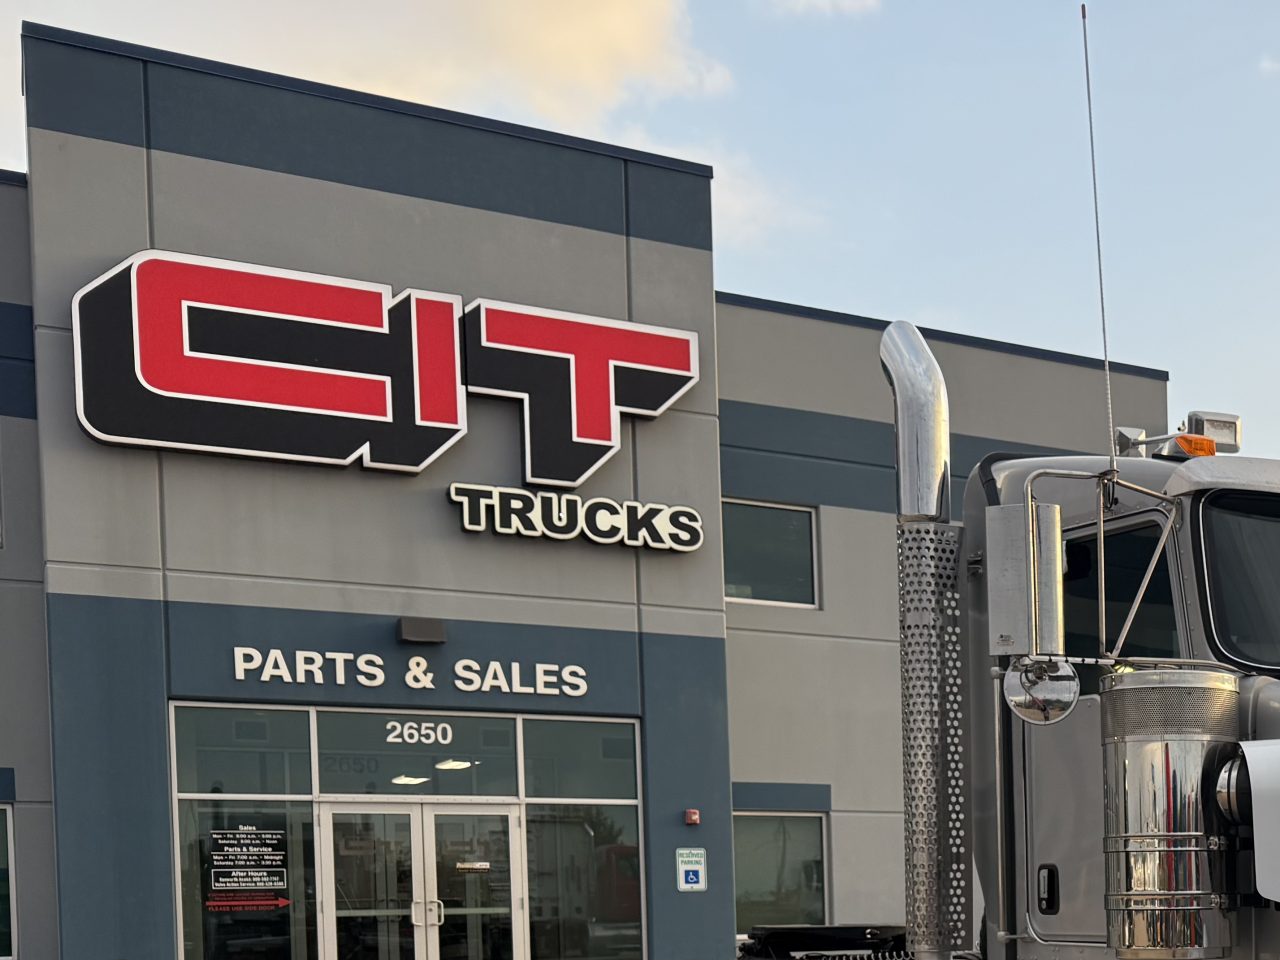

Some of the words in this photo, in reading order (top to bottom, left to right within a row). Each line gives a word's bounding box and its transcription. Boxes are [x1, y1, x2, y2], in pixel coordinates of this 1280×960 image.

[72, 249, 699, 488] CIT
[450, 482, 704, 552] TRUCKS
[233, 646, 385, 687] PARTS
[404, 656, 435, 689] &
[454, 659, 588, 697] SALES
[386, 721, 452, 744] 2650
